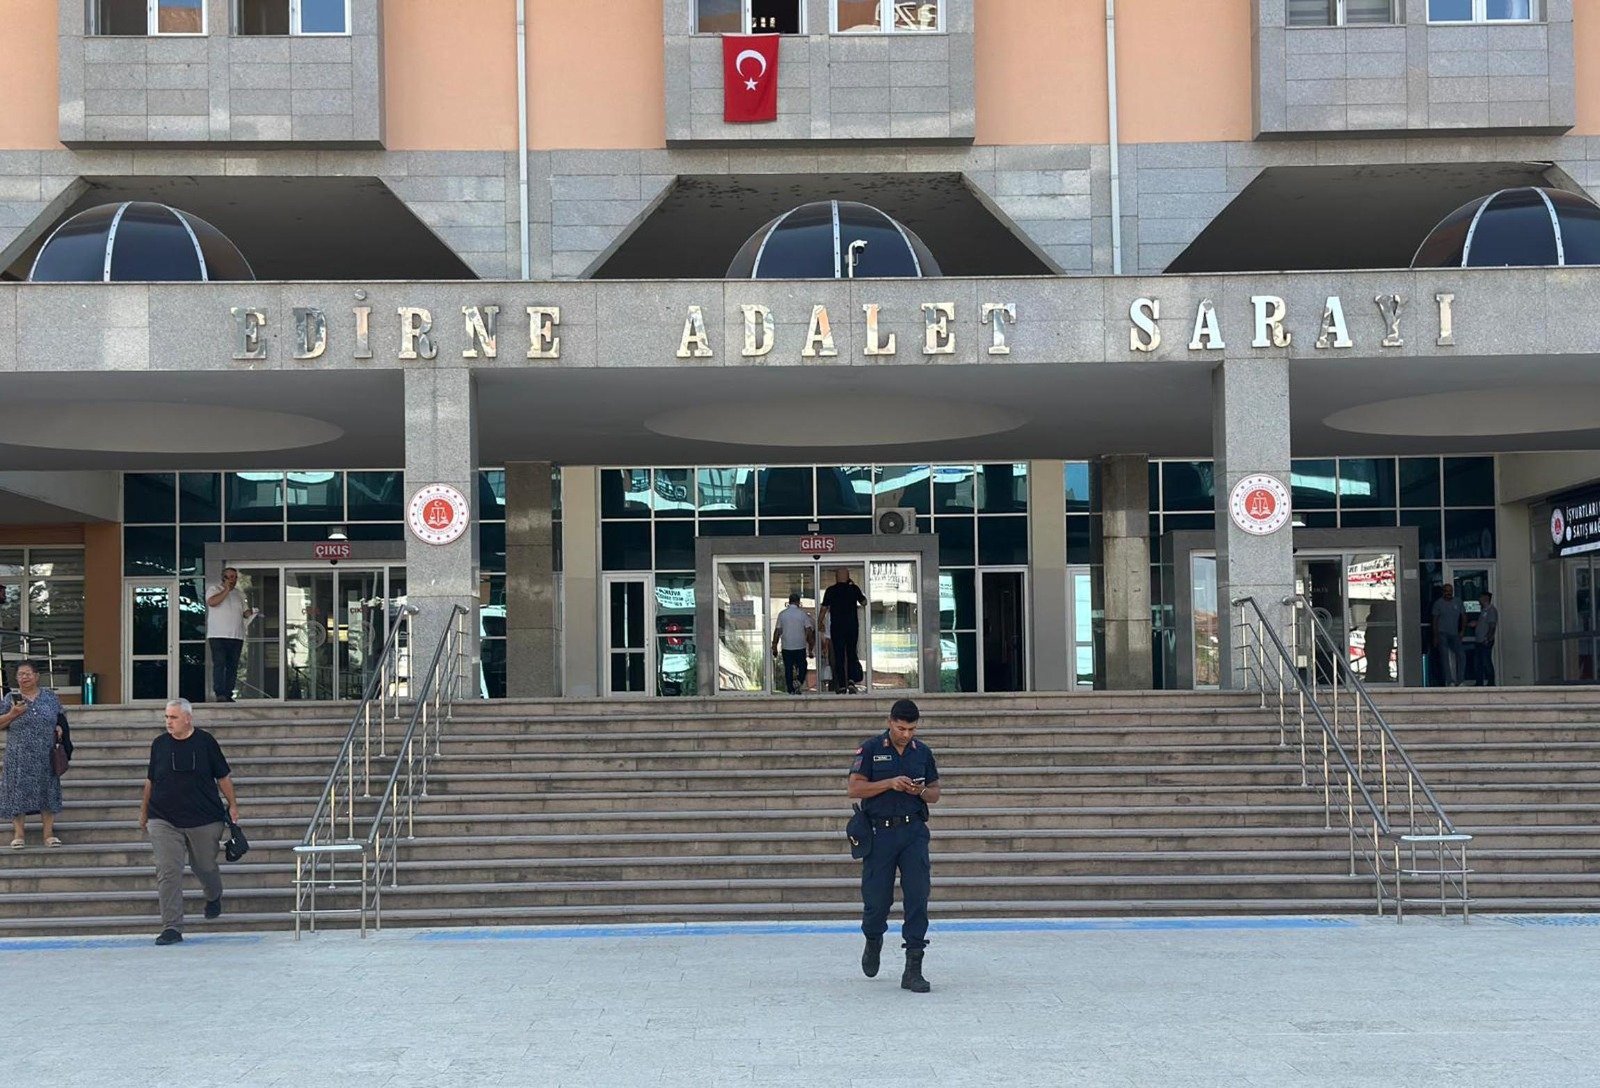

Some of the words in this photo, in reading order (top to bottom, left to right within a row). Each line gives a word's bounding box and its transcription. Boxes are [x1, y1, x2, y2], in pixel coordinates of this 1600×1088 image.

[230, 288, 561, 360] EDİRNE
[676, 301, 1017, 358] ADALET
[1129, 293, 1456, 352] SARAYI
[1572, 523, 1588, 539] SATIŞ
[315, 545, 349, 558] ÇIKIŞ
[801, 537, 834, 551] GİRİŞ
